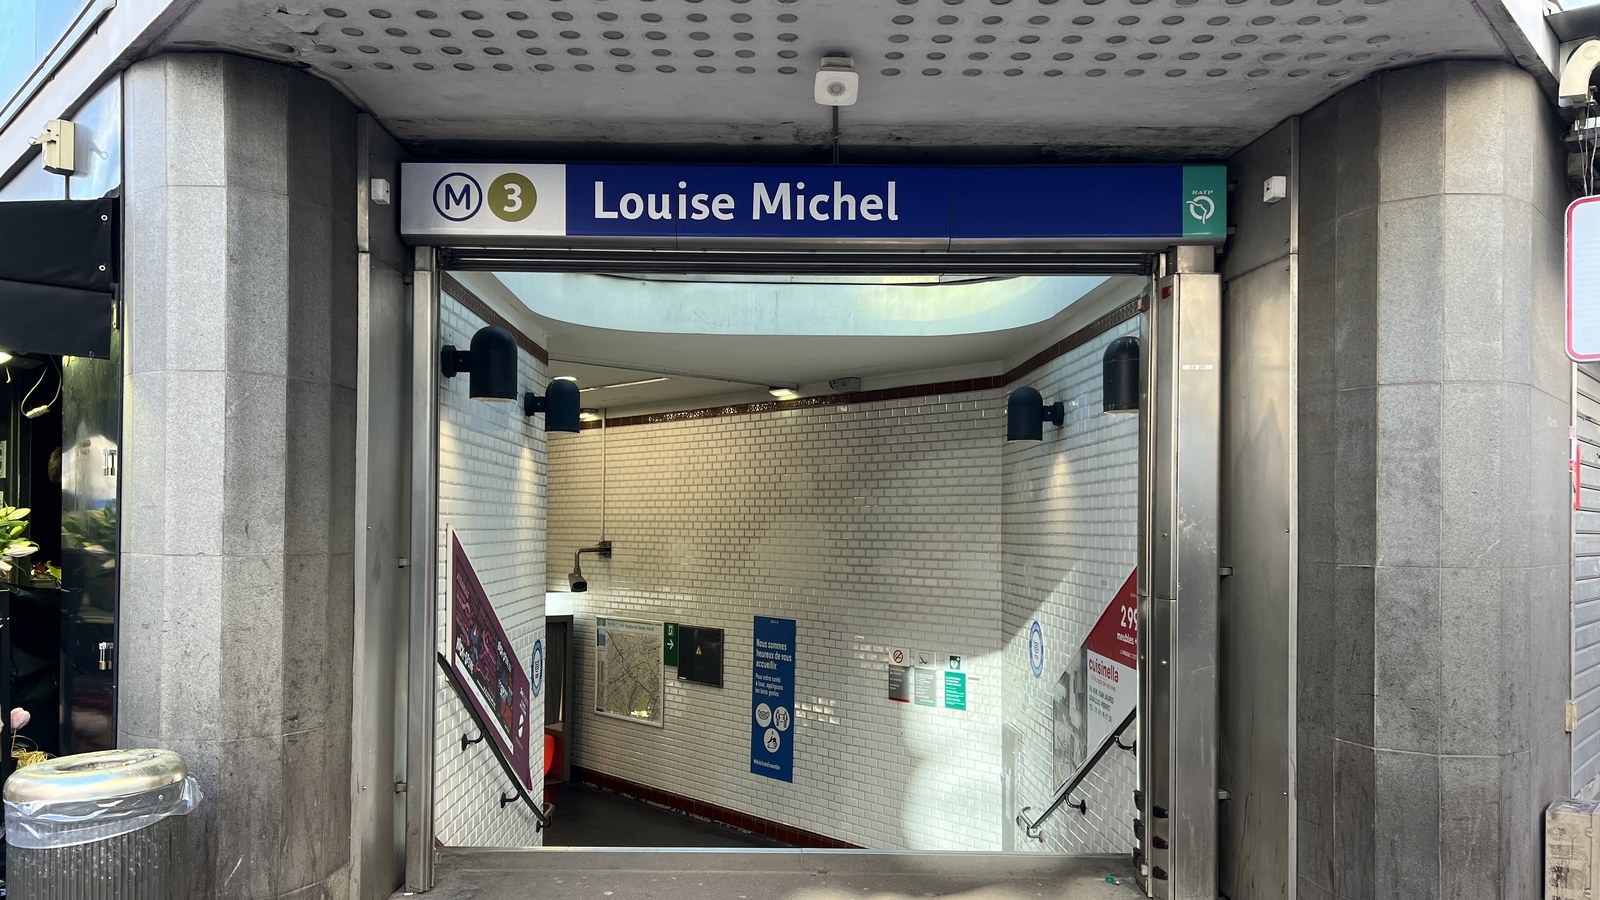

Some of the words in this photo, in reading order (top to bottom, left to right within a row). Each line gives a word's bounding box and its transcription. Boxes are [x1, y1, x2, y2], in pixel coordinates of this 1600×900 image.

[444, 183, 471, 211] M
[502, 183, 523, 213] 3
[594, 181, 736, 221] Louise
[752, 181, 899, 221] Michel
[756, 638, 768, 648] Nous
[768, 641, 787, 651] sommes
[756, 648, 774, 659] heureux
[775, 651, 781, 660] de
[781, 653, 792, 662] vous
[1089, 656, 1119, 683] cuisinella
